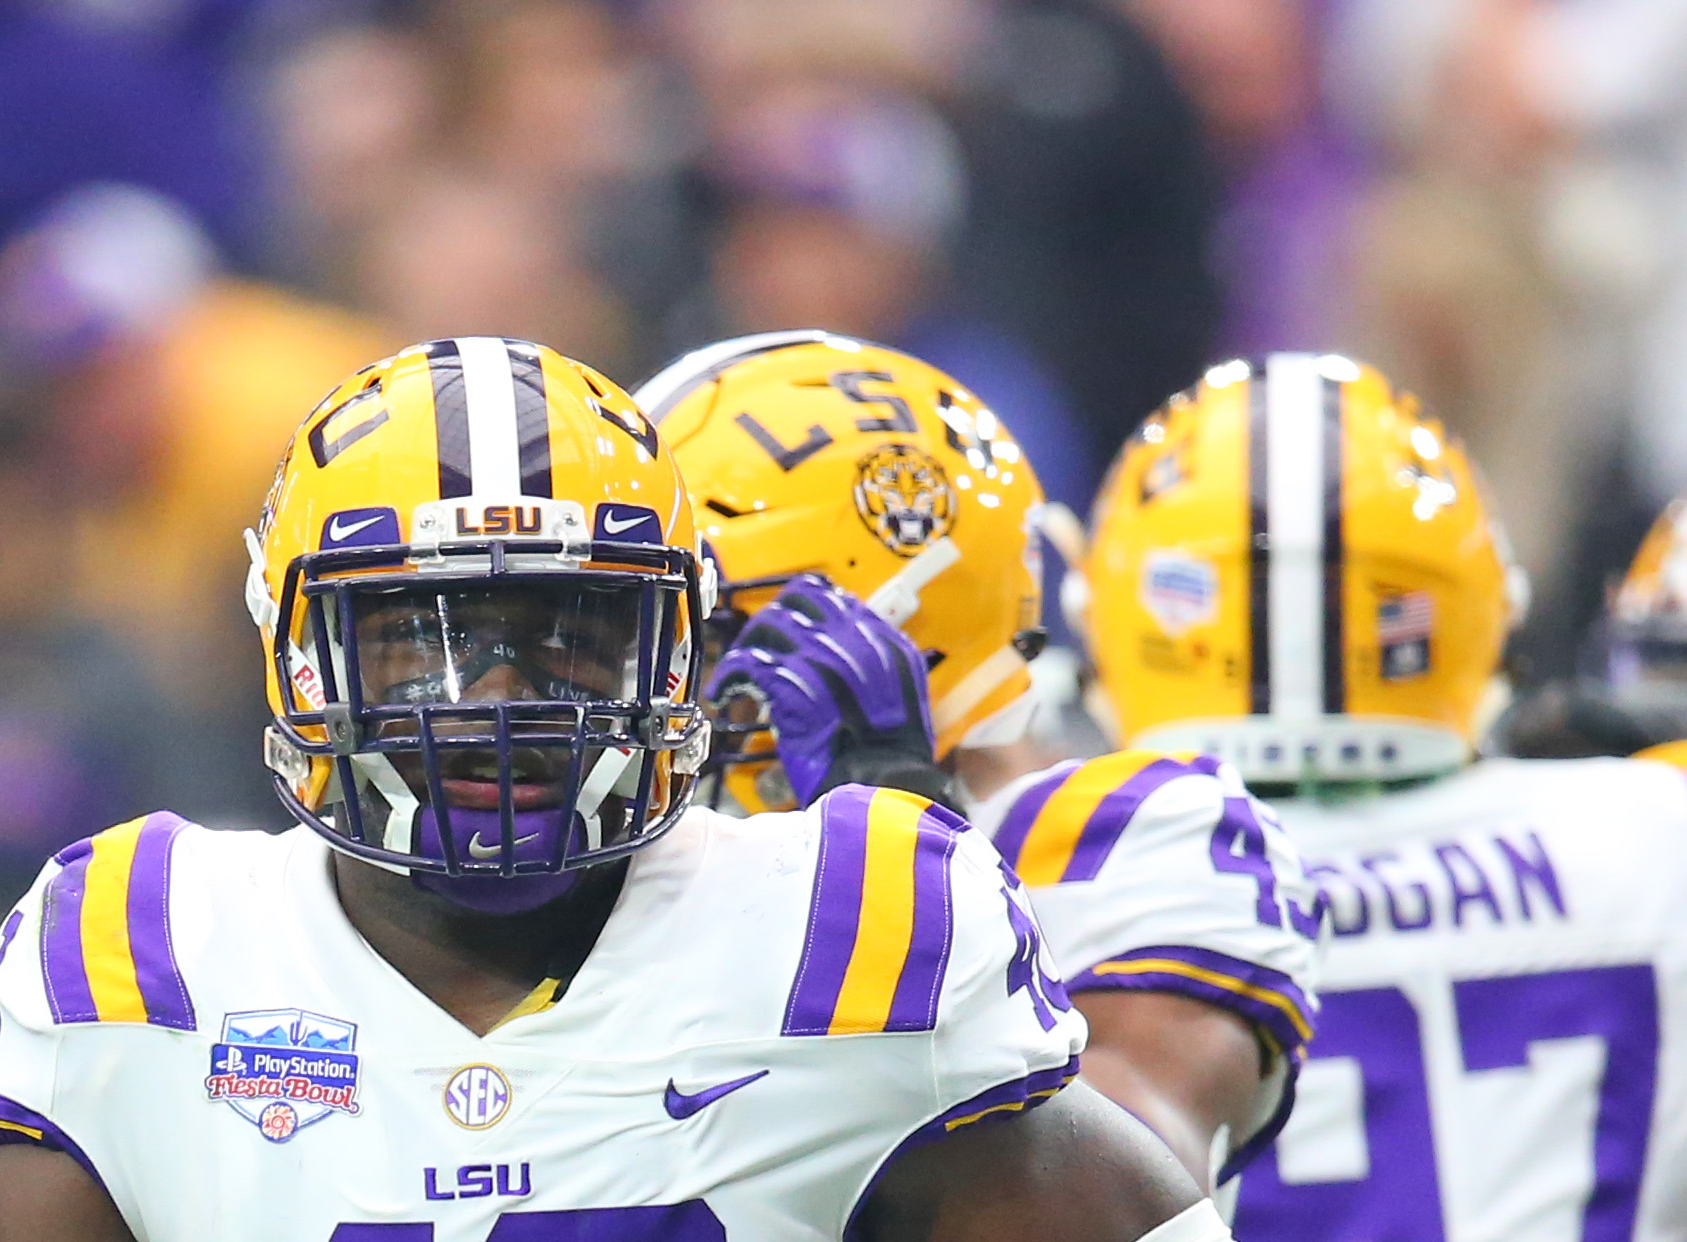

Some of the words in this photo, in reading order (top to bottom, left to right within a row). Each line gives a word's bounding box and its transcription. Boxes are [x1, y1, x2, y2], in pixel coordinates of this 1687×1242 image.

[456, 506, 541, 536] LSU
[1300, 833, 1564, 937] OGAN
[254, 1054, 351, 1078] PlayStation
[208, 1073, 281, 1097] Fiesta
[285, 1078, 354, 1108] Bowl
[448, 1068, 507, 1126] SEC
[424, 1162, 531, 1200] LSU
